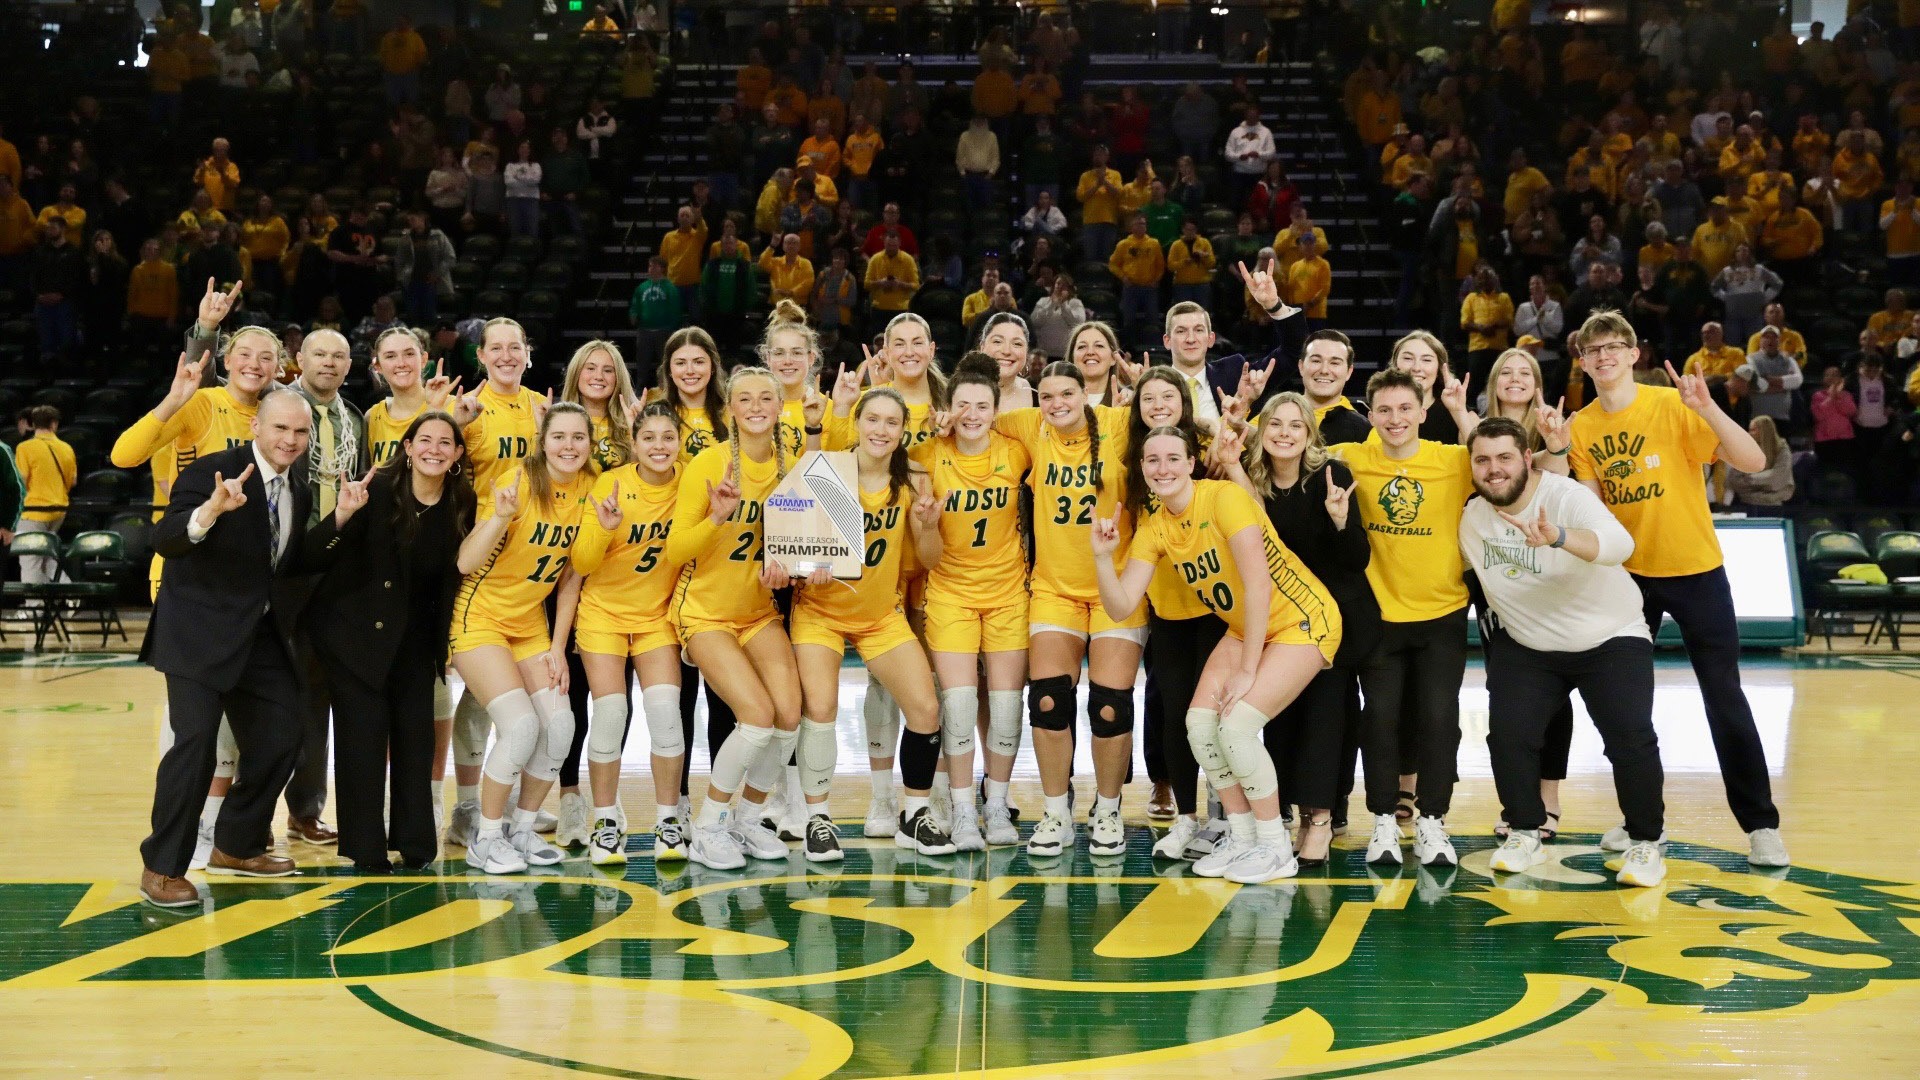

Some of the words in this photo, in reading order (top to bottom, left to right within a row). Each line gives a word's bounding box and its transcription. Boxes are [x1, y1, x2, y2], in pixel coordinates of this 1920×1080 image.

[373, 440, 401, 462] ND
[498, 436, 533, 459] ND
[902, 431, 935, 448] DS
[1588, 431, 1645, 466] NDSU
[1645, 454, 1660, 469] 90
[1045, 462, 1103, 488] NDSU
[768, 498, 815, 508] SUMMIT
[945, 487, 1009, 512] NDSU
[1603, 480, 1664, 506] Bison
[864, 506, 900, 534] DSU
[1053, 495, 1097, 524] 32
[627, 519, 673, 545] NDS
[767, 535, 804, 543] REGULAR
[806, 536, 839, 544] SEASON
[972, 518, 988, 548] 1
[1368, 522, 1432, 536] BASKETBALL
[635, 547, 663, 573] 5
[767, 544, 849, 556] CHAMPION
[526, 555, 568, 583] 12
[1174, 548, 1221, 584] DSU
